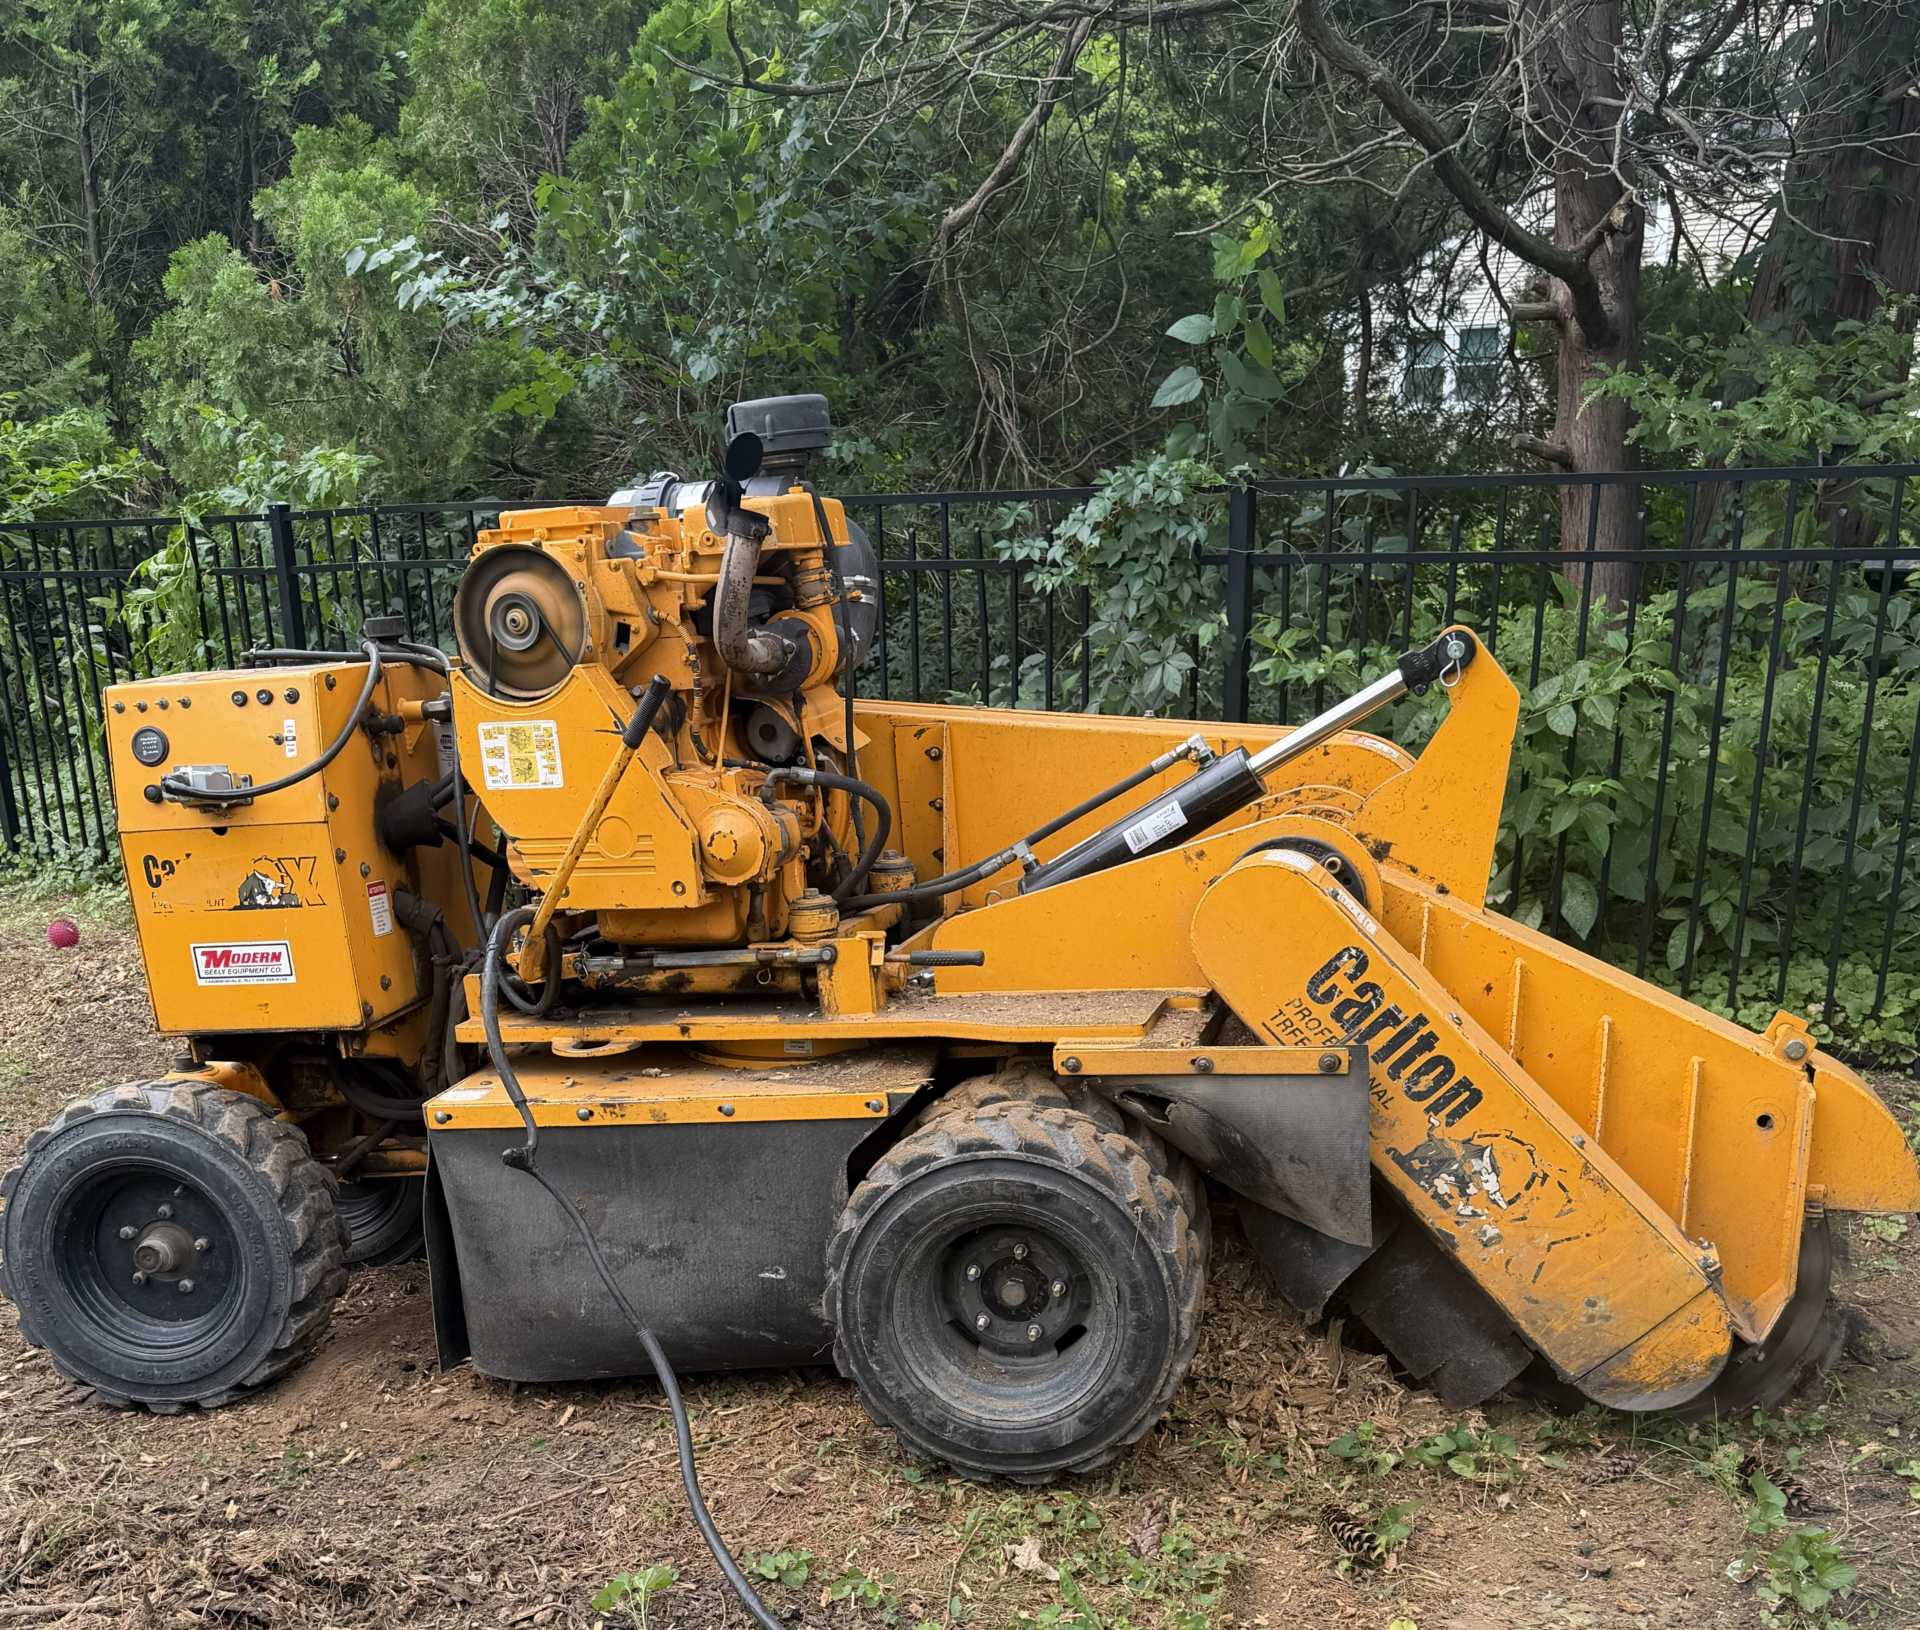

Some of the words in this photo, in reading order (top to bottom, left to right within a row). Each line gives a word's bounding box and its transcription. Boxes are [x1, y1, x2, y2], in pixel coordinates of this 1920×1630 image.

[1305, 946, 1484, 1128] Carlton
[231, 1162, 265, 1206] POWER
[136, 1369, 182, 1380] GUARD
